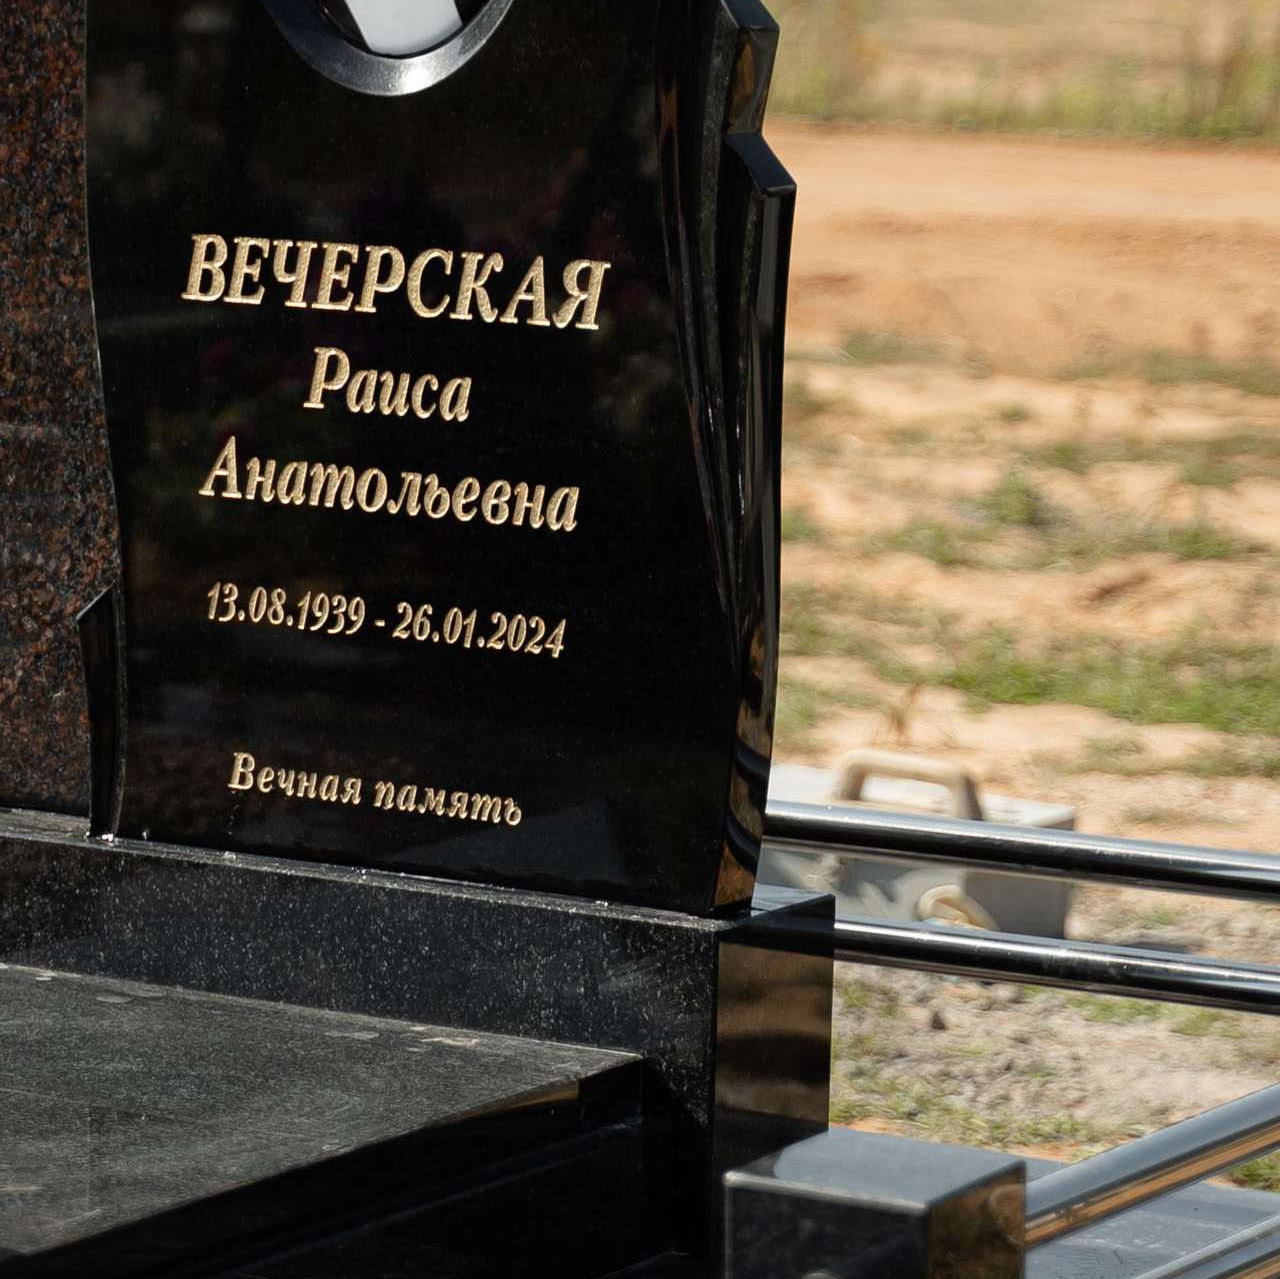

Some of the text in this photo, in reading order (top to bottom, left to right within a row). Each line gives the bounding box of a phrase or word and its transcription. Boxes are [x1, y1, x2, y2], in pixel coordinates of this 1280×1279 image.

[181, 233, 611, 331] ВЕЧЕРСКАЯ
[303, 346, 472, 422] Раиса
[198, 435, 580, 532] Анатольевна
[207, 581, 366, 635] 13.08.1939
[392, 602, 567, 659] 26.01.2024
[228, 751, 522, 826] Вечная память
